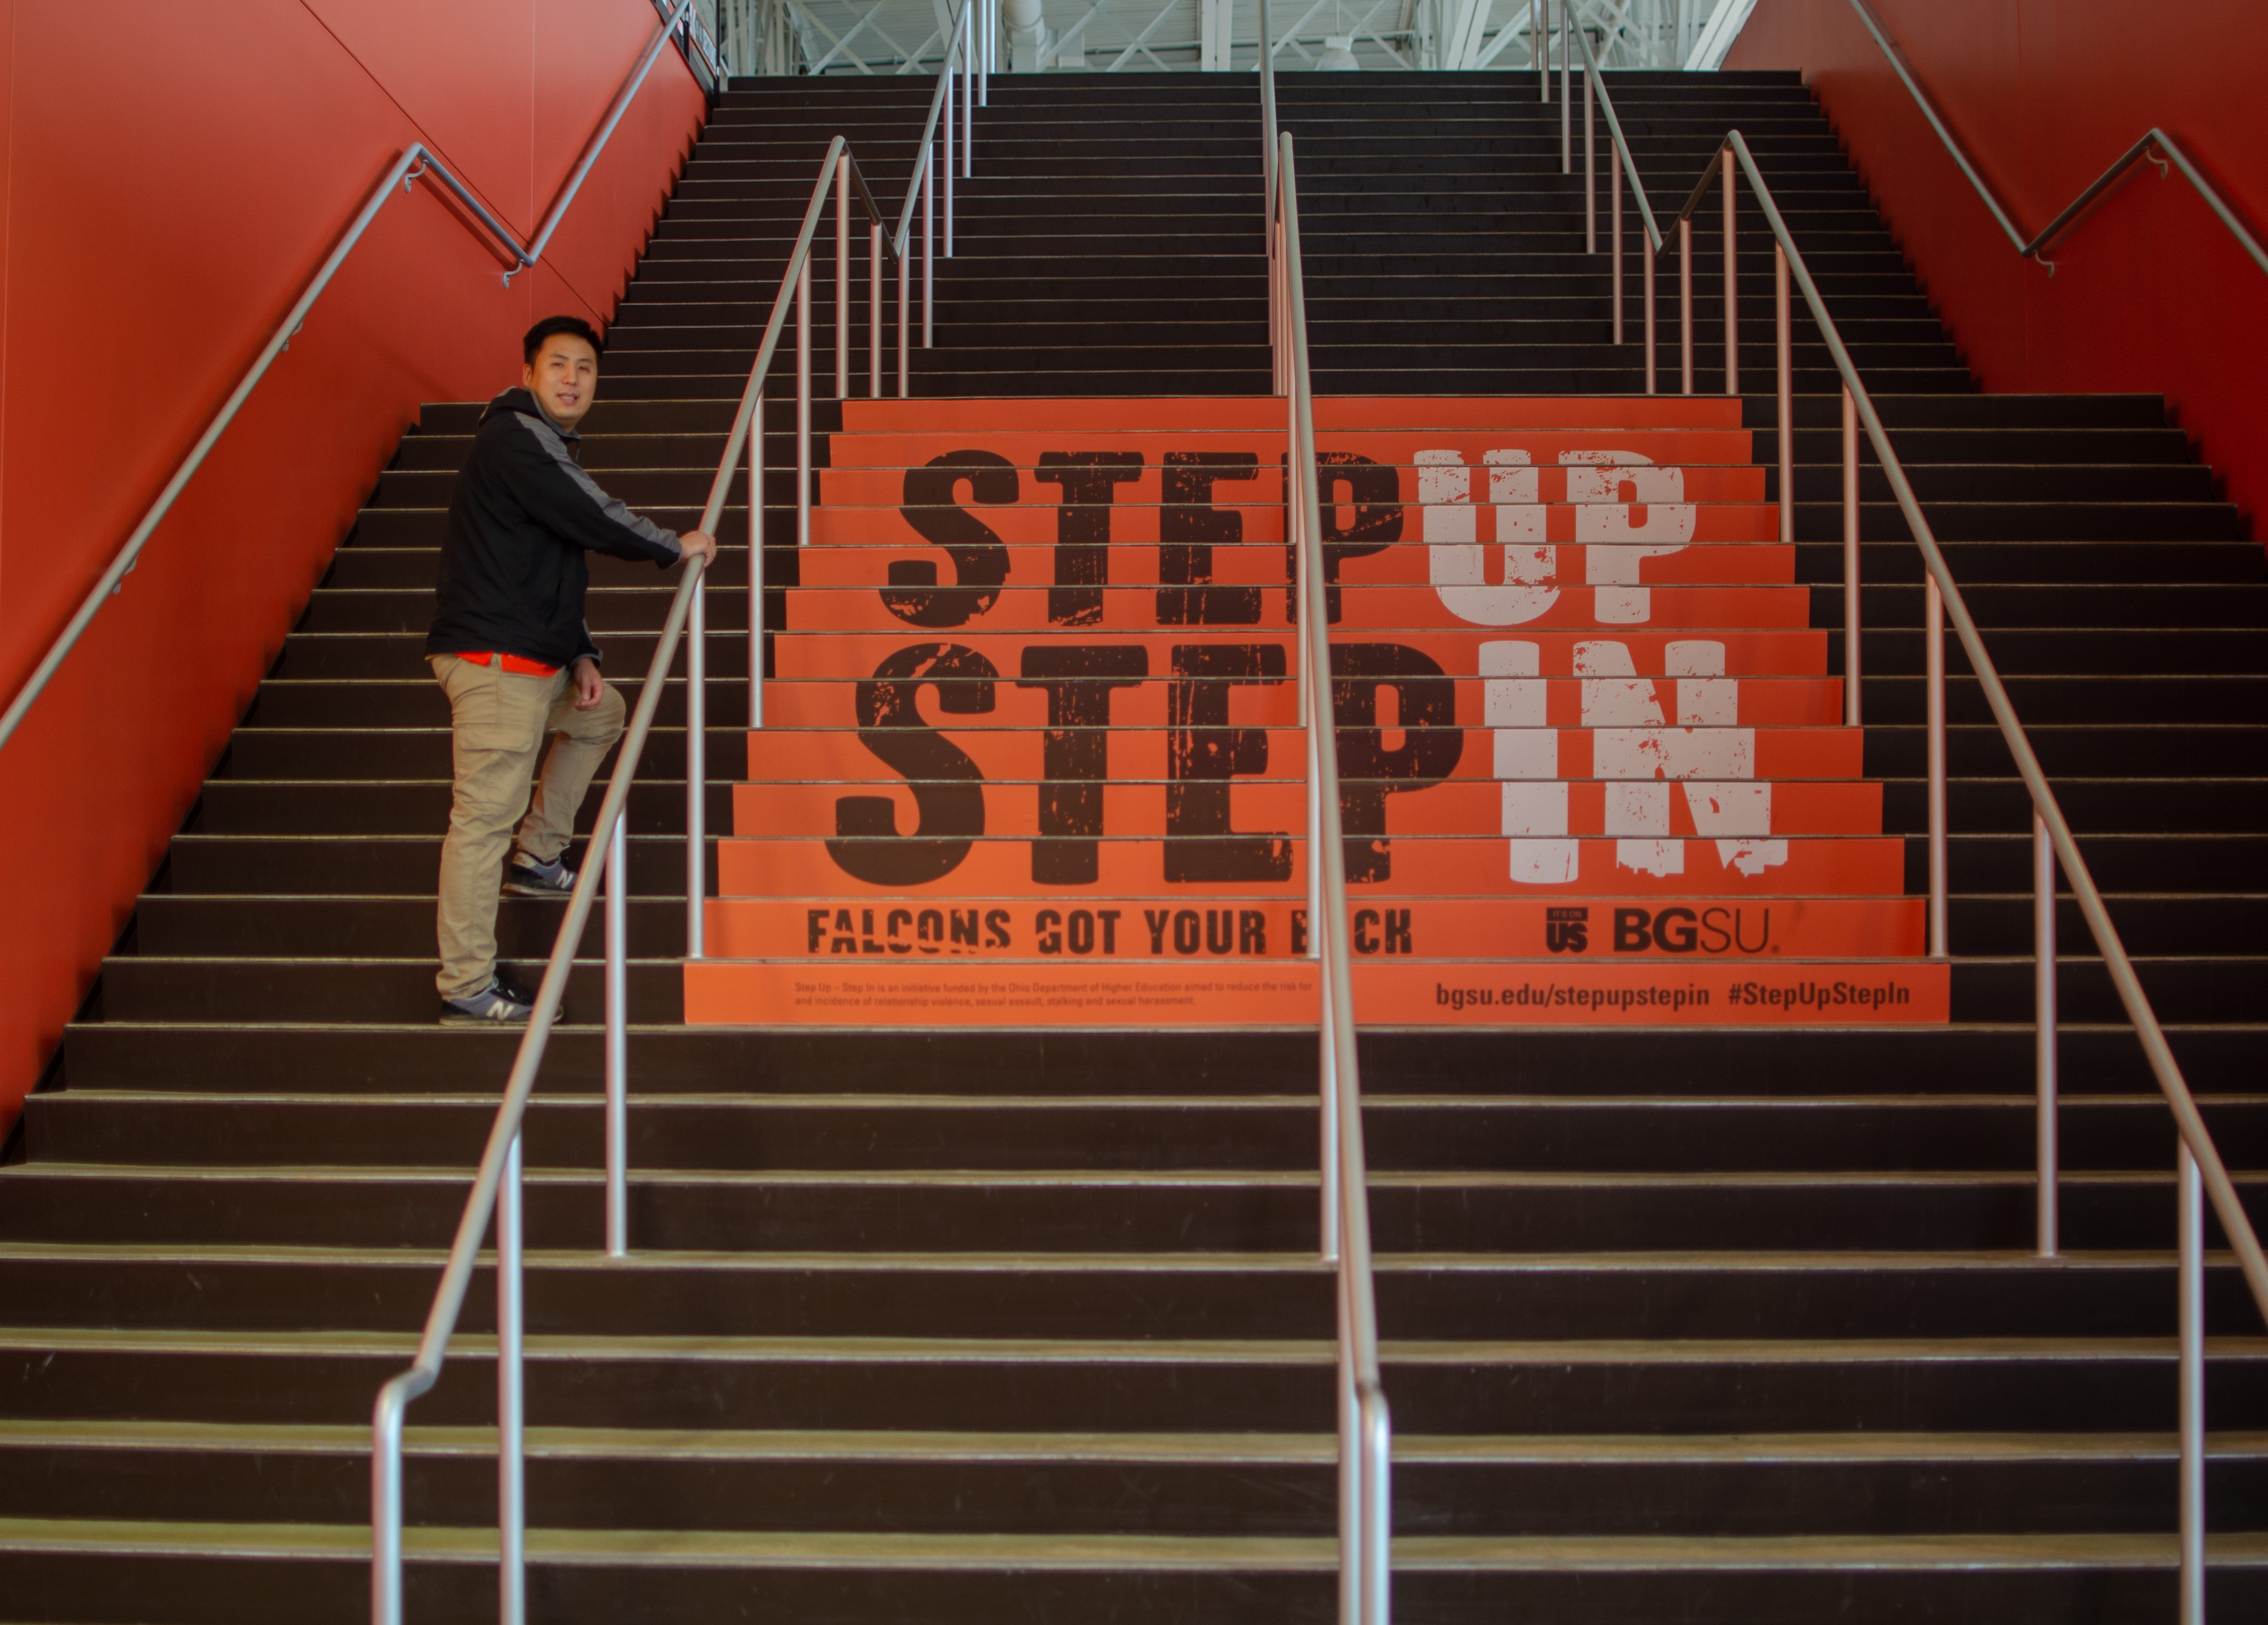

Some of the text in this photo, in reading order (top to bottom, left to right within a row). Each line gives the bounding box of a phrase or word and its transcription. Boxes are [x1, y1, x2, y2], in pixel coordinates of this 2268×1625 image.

[879, 448, 1696, 628] STEP UP
[825, 640, 1788, 886] STEP IN
[556, 870, 574, 889] N
[808, 908, 1412, 955] FALCONS GOT YOUR BCK
[1546, 922, 1588, 953] US
[795, 982, 816, 993] Step
[818, 983, 831, 993] Up
[843, 982, 863, 993] Step
[866, 983, 875, 992] In
[943, 983, 975, 992] funded
[978, 983, 989, 994] by
[991, 983, 1006, 992] the
[1009, 982, 1030, 992] Ohio
[1033, 982, 1087, 993] Department
[1090, 983, 1099, 992] of
[1102, 983, 1132, 993] Higher
[1135, 982, 1181, 991] Education
[1184, 982, 1213, 991] aimed
[1215, 982, 1225, 991] to
[1227, 982, 1260, 991] reduce
[1262, 982, 1277, 991] the
[1280, 982, 1297, 991] risk
[1299, 981, 1311, 991] for
[795, 997, 812, 1005] and
[863, 997, 872, 1005] of
[875, 997, 929, 1007] relationship
[931, 997, 972, 1006] violence,
[975, 997, 1005, 1005] sexual
[1008, 997, 1044, 1006] assault,
[1047, 997, 1083, 1007] stalking
[1086, 997, 1103, 1005] and
[1106, 997, 1136, 1005] sexual
[1138, 996, 1195, 1005] harassment.
[1436, 982, 1910, 1011] bgsu.edu/stepupstepin #StepUpStepIn
[487, 1001, 514, 1020] N
